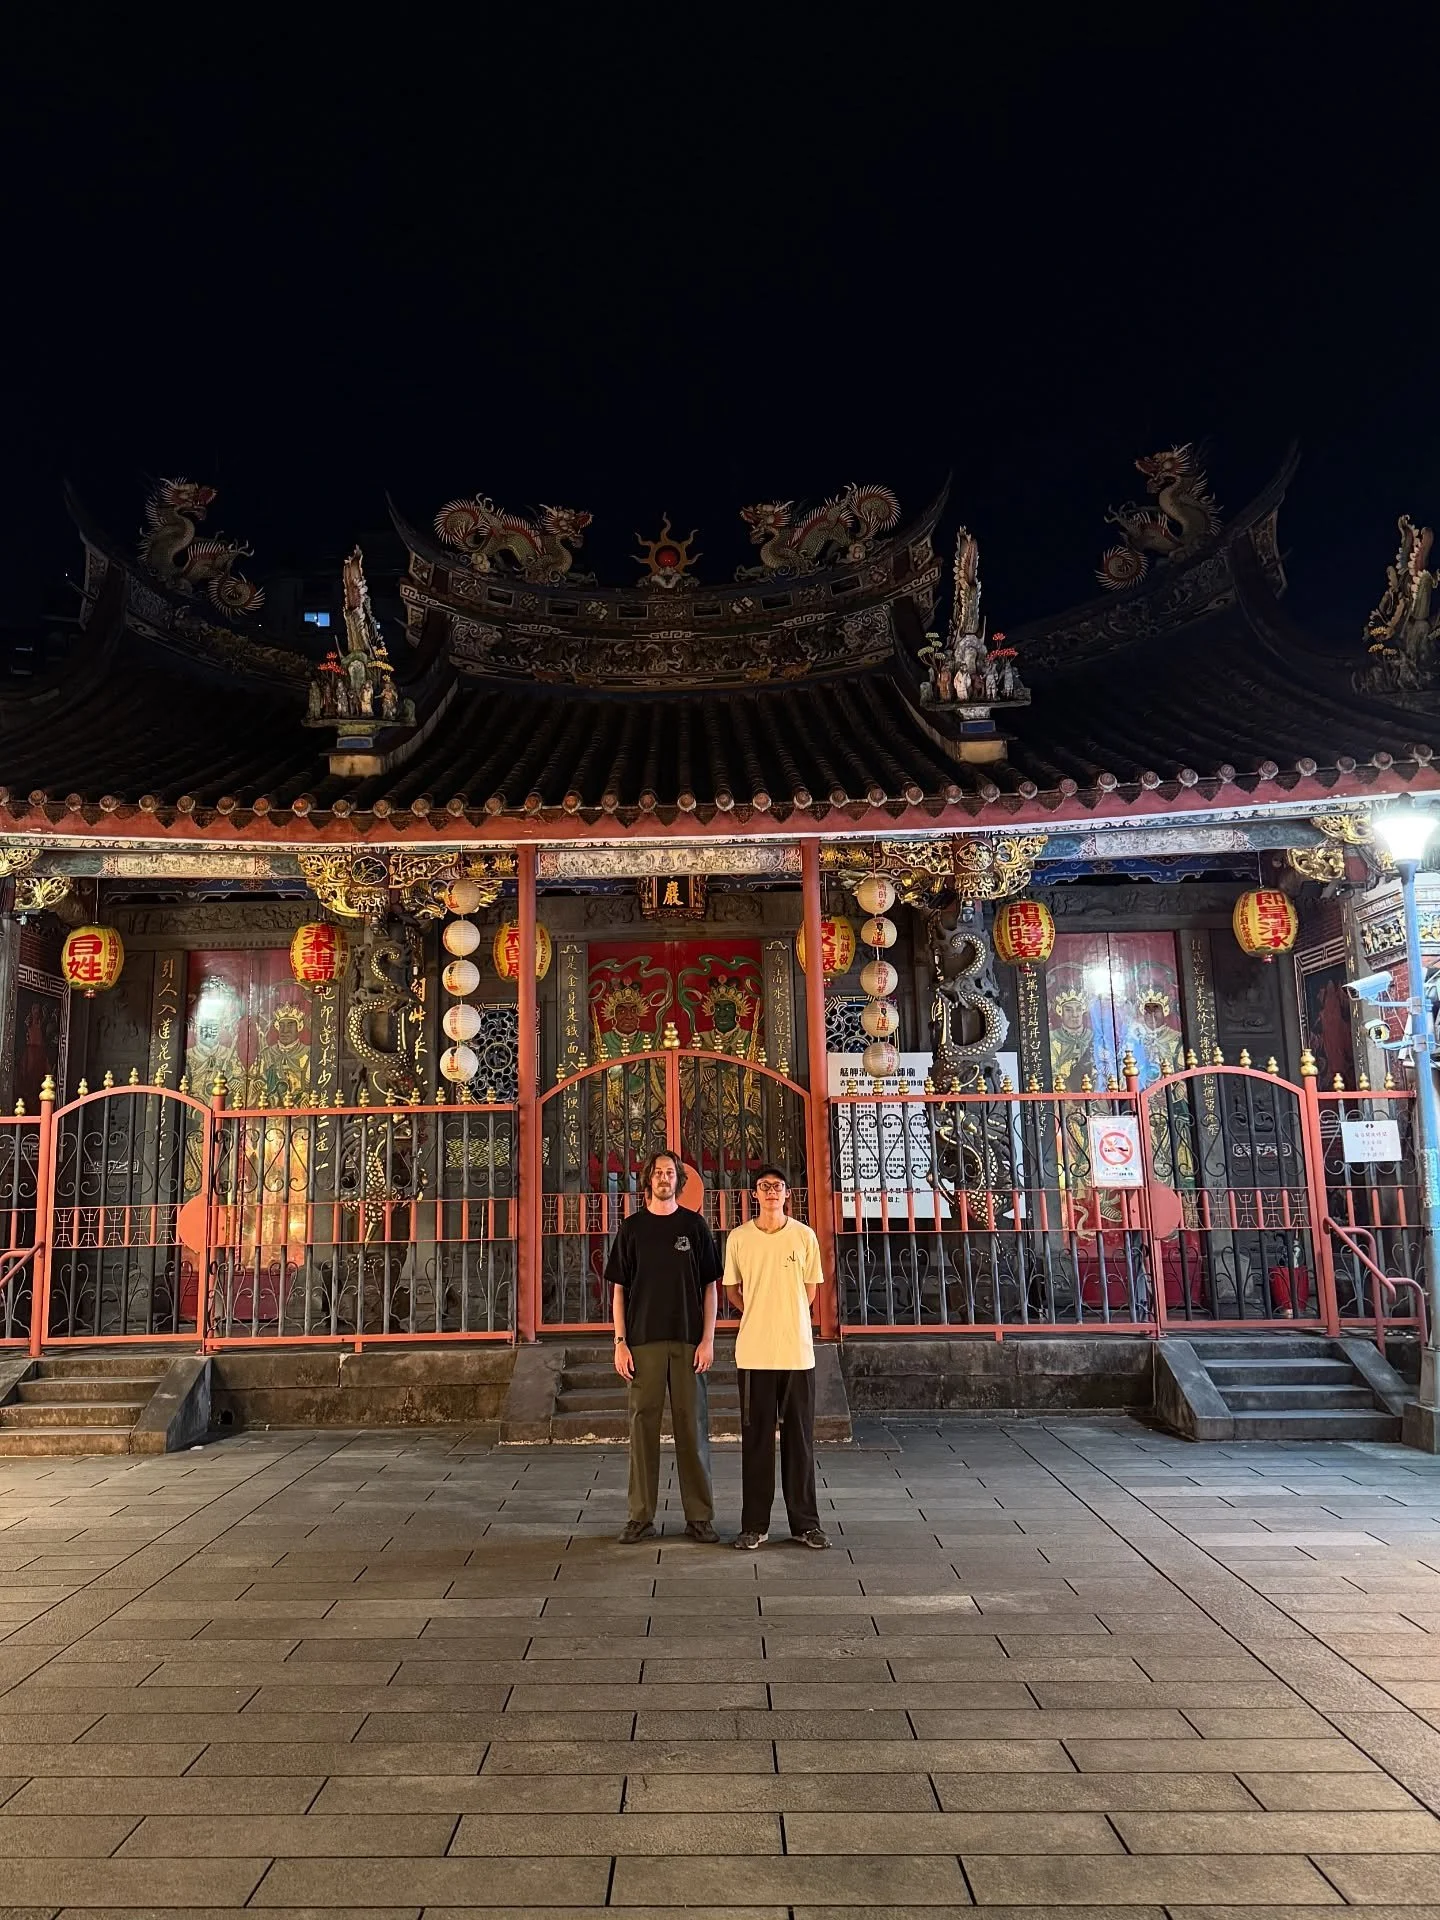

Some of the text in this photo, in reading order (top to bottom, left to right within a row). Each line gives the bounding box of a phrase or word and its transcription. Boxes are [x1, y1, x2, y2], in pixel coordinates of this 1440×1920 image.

[663, 880, 684, 905] 巖
[1008, 903, 1042, 958] 雨暘時若
[1256, 890, 1291, 948] 即是清水
[67, 934, 103, 981] 百姓
[301, 924, 336, 981] 清水祖師
[840, 1067, 916, 1077] 艋舺清師廟
